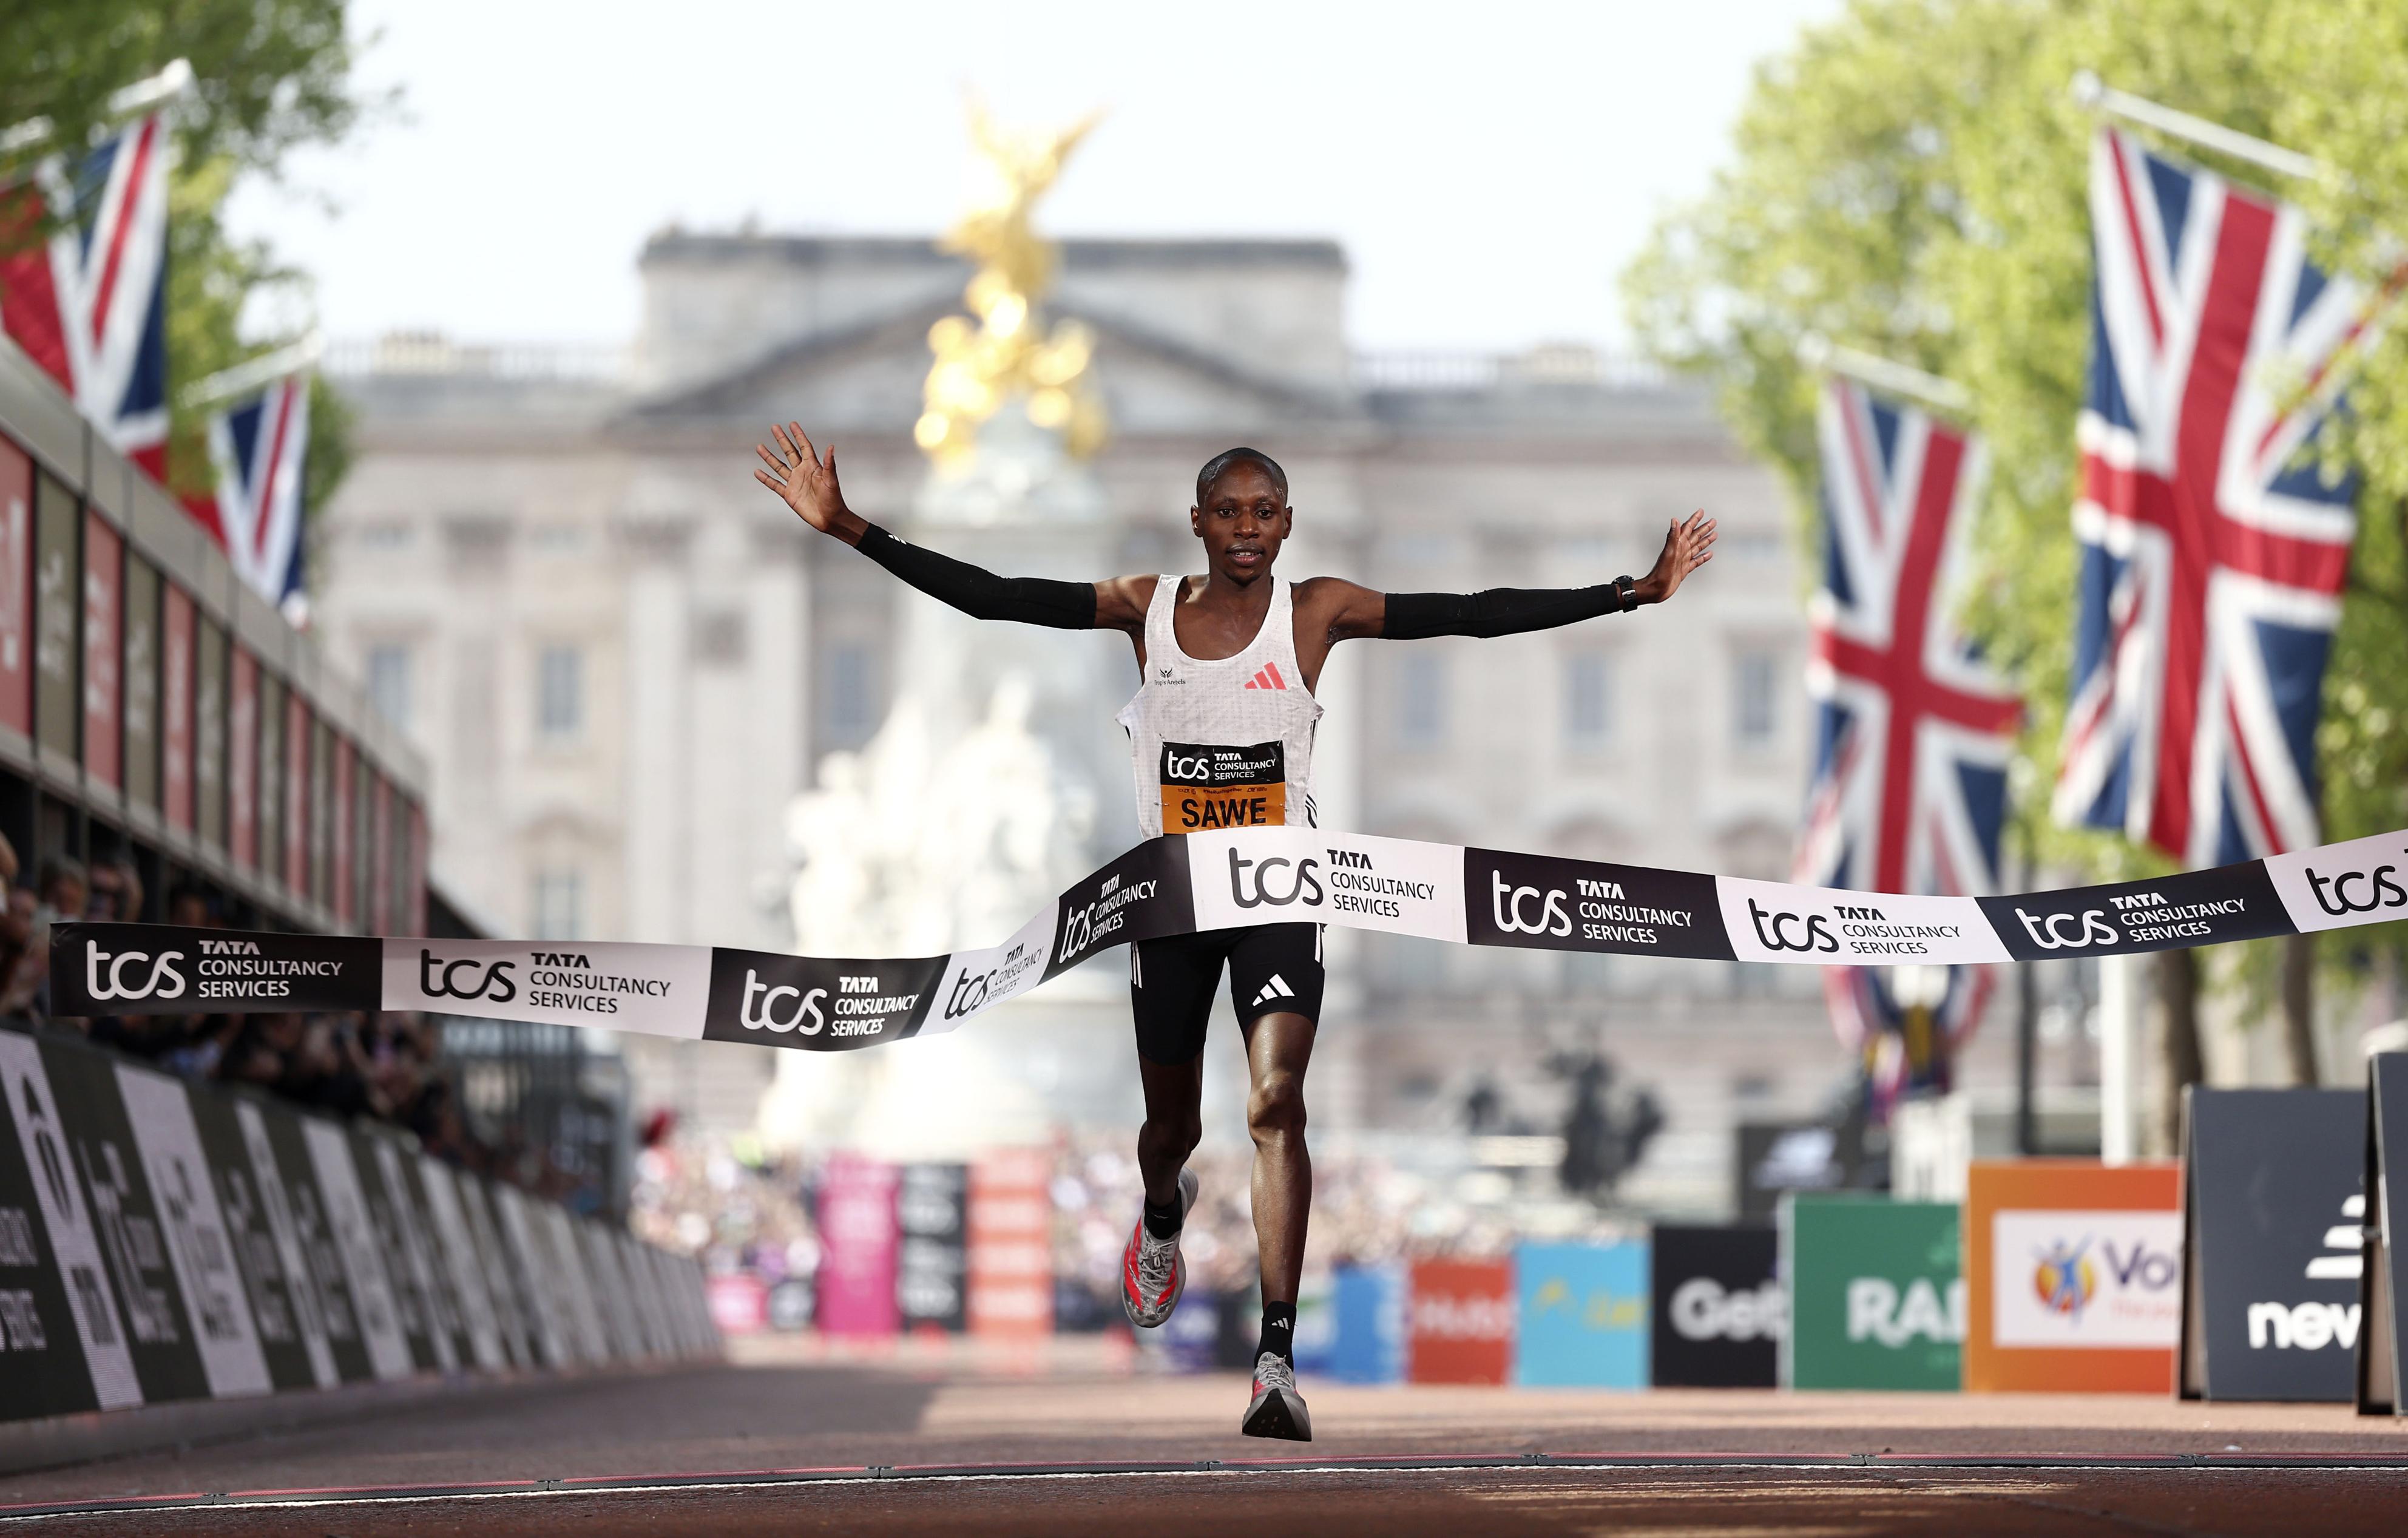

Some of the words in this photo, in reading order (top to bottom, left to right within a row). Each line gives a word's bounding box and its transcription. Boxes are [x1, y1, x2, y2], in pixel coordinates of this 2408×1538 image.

[1168, 750, 1209, 780] tcs
[1214, 753, 1242, 761] TATA
[1214, 758, 1276, 771] CONSULTANCY
[1214, 771, 1255, 781] SERVICES
[1181, 798, 1267, 828] SAWE
[1327, 849, 1373, 870] TATA
[1101, 873, 1120, 899] TATA
[1228, 847, 1324, 909] tcs
[1330, 872, 1435, 901] CONSULTANCY
[1576, 878, 1625, 900] TATA
[2305, 865, 2408, 915] tcs
[1095, 879, 1157, 921] CONSULTANCY
[1334, 893, 1399, 918] SERVICES
[1492, 869, 1572, 937] tcs
[2109, 892, 2169, 910] TATA
[2120, 898, 2246, 926] CONSULTANCY
[1579, 901, 1692, 927] CONSULTANCY
[1748, 898, 1839, 953] tcs
[1833, 906, 1886, 921] TATA
[1058, 902, 1095, 964] tcs
[1091, 910, 1123, 944] SERVICES
[1582, 923, 1657, 944] SERVICES
[1842, 924, 1961, 938] CONSULTANCY
[2014, 907, 2120, 949] tcs
[2129, 921, 2212, 943] SERVICES
[198, 940, 260, 955] TATA
[1004, 943, 1024, 966] TATA
[1850, 941, 1928, 954] SERVICES
[87, 940, 186, 1000] tcs
[198, 959, 343, 976] CONSULTANCY
[531, 952, 590, 969] TATA
[995, 946, 1044, 986] CONSULTANCY
[421, 949, 516, 1003] tcs
[530, 971, 671, 997] CONSULTANCY
[839, 977, 878, 993] TATA
[198, 981, 290, 998] SERVICES
[944, 967, 998, 1020] tcs
[984, 977, 1020, 1004] SERVICES
[529, 991, 618, 1014] SERVICES
[740, 969, 828, 1036] tcs
[834, 994, 919, 1015] CONSULTANCY
[830, 1017, 885, 1037] SERVICES
